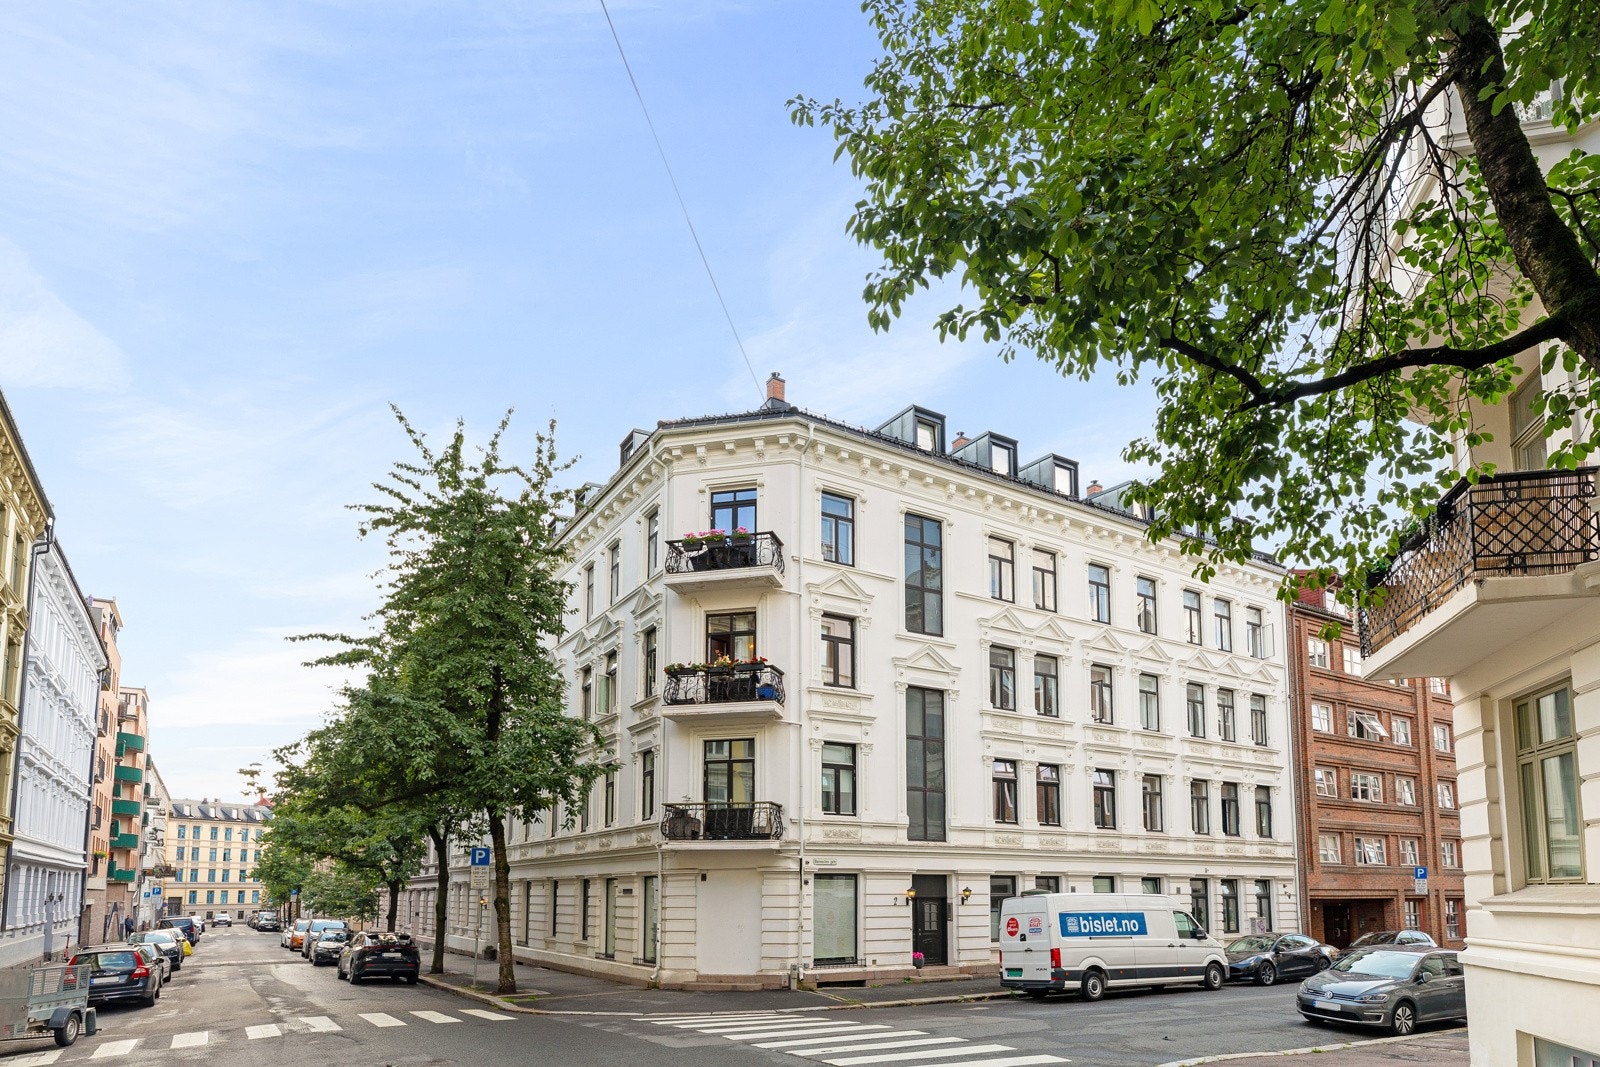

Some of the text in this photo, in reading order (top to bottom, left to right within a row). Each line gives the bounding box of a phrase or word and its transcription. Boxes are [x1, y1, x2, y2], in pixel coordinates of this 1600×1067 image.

[475, 850, 486, 863] P
[1417, 868, 1425, 878] P
[893, 896, 898, 905] 2
[1079, 916, 1139, 933] bislet.no
